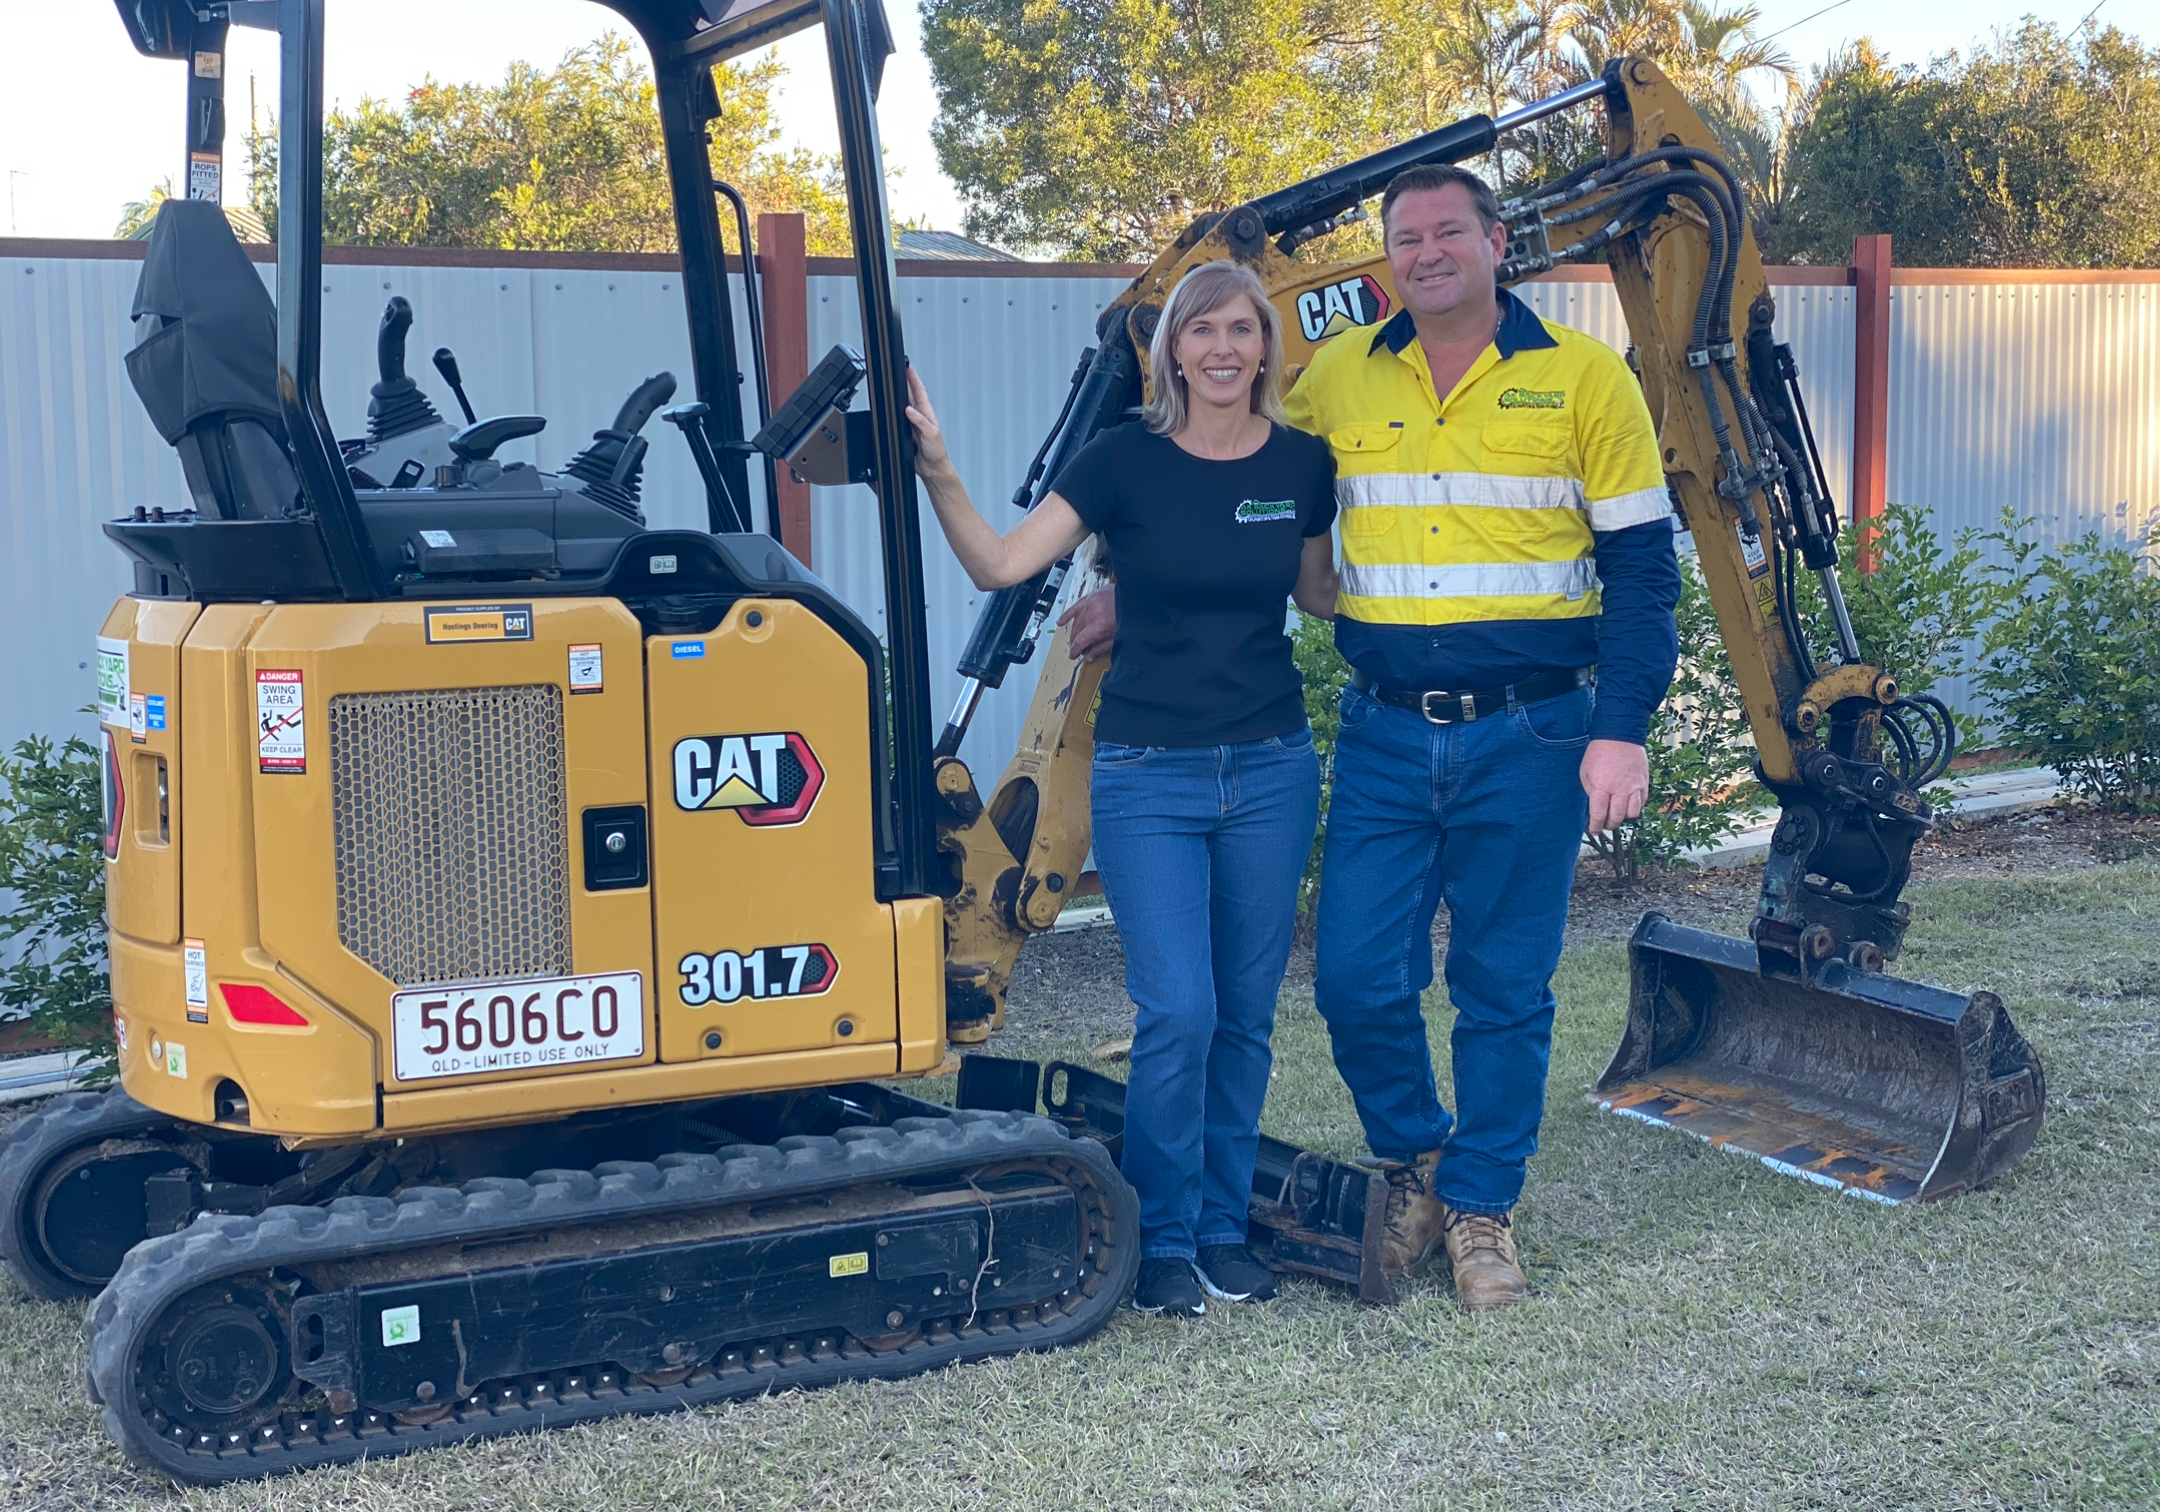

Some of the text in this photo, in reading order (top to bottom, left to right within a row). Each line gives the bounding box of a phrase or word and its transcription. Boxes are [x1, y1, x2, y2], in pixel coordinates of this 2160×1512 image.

[195, 163, 217, 171] ROPS
[192, 170, 219, 179] FITTED
[1297, 277, 1365, 340] CAT
[442, 618, 525, 631] Hastings Deering CAT
[674, 645, 702, 654] DIESEL
[262, 685, 296, 695] SWING
[266, 695, 294, 704] AREA
[261, 746, 302, 755] KEEP CLEAR
[674, 734, 786, 809] CAT
[187, 951, 201, 960] HOT
[680, 946, 809, 1004] 301.7
[539, 1047, 566, 1062] USE
[574, 1043, 609, 1058] ONLY
